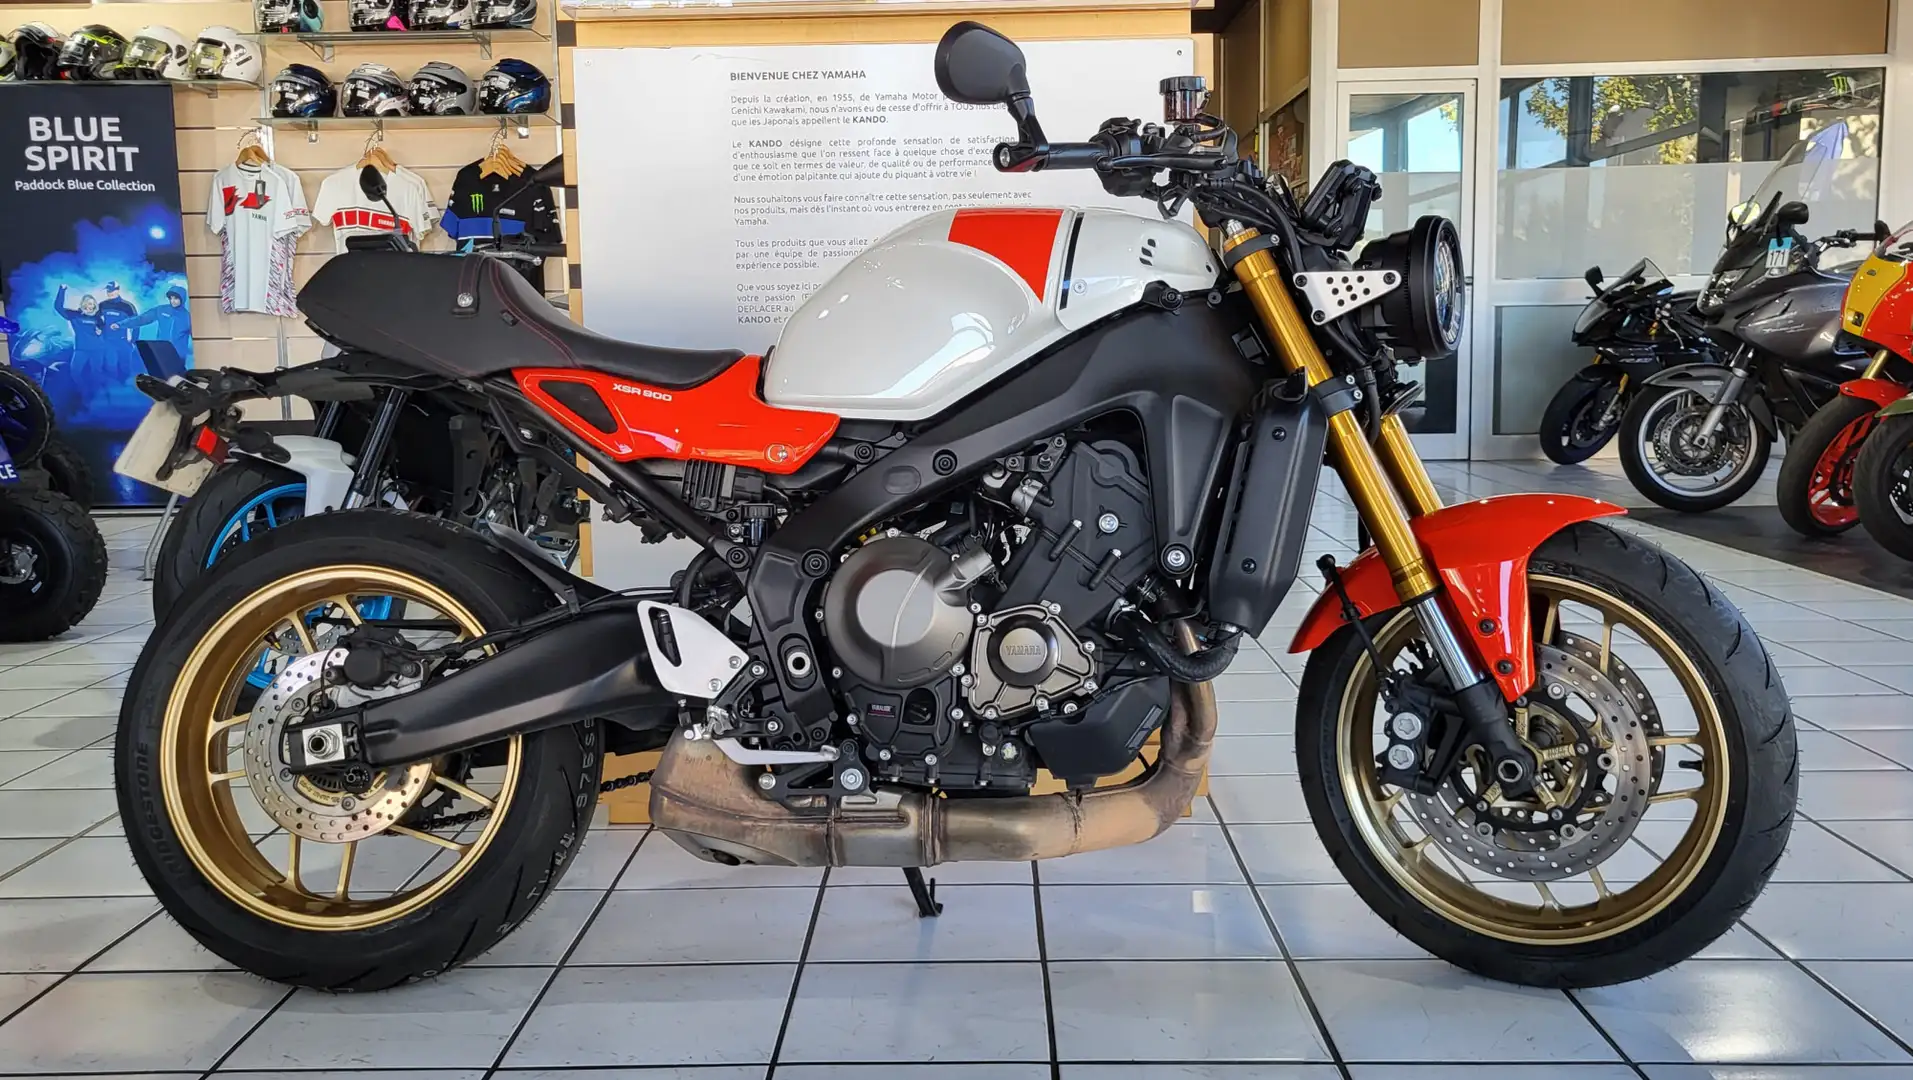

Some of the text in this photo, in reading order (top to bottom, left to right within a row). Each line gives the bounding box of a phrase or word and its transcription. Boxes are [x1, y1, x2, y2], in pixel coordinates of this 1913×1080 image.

[730, 70, 866, 81] BIENVENUE CHEZ YAMAHA
[730, 94, 760, 105] Depuis
[763, 94, 771, 102] la
[776, 93, 812, 103] création,
[832, 92, 855, 102] 1955,
[860, 92, 870, 101] de
[874, 91, 908, 100] Yamaha
[912, 91, 938, 100] Motor
[764, 105, 808, 115] Kawakami,
[830, 104, 862, 113] n'avons
[876, 103, 888, 112] de
[912, 102, 942, 111] d'offrir
[950, 103, 974, 111] TOUS
[992, 102, 1006, 110] clie
[731, 115, 888, 127] que les Japonais appellent le KANDO.
[28, 116, 122, 142] BLUE
[732, 139, 742, 148] Le
[748, 140, 782, 148] KANDO
[790, 138, 822, 149] désigne
[828, 137, 852, 146] cette
[857, 137, 897, 148] profonde
[902, 136, 944, 145] sensation
[950, 136, 960, 144] de
[24, 146, 140, 172] SPIRIT
[732, 149, 798, 159] d'enthousiasme
[801, 151, 817, 160] que
[820, 149, 836, 158] l'on
[840, 148, 870, 157] ressent
[872, 148, 892, 157] face
[902, 148, 937, 159] quelque
[940, 147, 964, 156] chose
[968, 147, 994, 156] d'exce
[732, 163, 748, 172] que
[762, 161, 778, 169] soit
[794, 160, 824, 169] termes
[826, 160, 836, 169] de
[838, 159, 866, 170] valeur,
[868, 159, 880, 168] de
[881, 159, 910, 170] qualité
[926, 159, 937, 167] de
[732, 172, 756, 181] d'une
[758, 171, 793, 180] émotion
[795, 171, 838, 182] palpitante
[839, 171, 852, 181] qui
[854, 170, 880, 181] ajoute
[882, 170, 894, 179] du
[895, 170, 927, 180] piquant
[936, 169, 958, 178] votre
[960, 169, 972, 178] vie
[15, 179, 156, 192] Paddock Blue Collection
[734, 194, 755, 203] Nous
[756, 194, 800, 203] souhaitons
[824, 193, 844, 202] faire
[844, 192, 884, 201] connaître
[885, 192, 908, 201] cette
[908, 191, 951, 202] sensation,
[952, 193, 966, 202] pas
[968, 190, 1012, 199] seulement
[750, 204, 788, 216] produits,
[789, 204, 809, 213] mais
[810, 204, 825, 213] dès
[826, 203, 860, 212] l'instant
[861, 203, 872, 212] où
[894, 202, 930, 211] entrerez
[734, 216, 769, 225] Yamaha.
[736, 238, 755, 247] Tous
[757, 238, 769, 247] les
[771, 238, 806, 249] produits
[808, 240, 824, 248] que
[848, 238, 868, 246] allez
[736, 251, 750, 260] par
[774, 249, 803, 260] équipe
[808, 249, 818, 257] de
[822, 248, 862, 259] passionn
[736, 260, 820, 271] expérience possible.
[736, 282, 754, 293] Que
[776, 283, 800, 292] soyez
[802, 281, 810, 290] ici
[736, 293, 760, 302] votre
[764, 292, 796, 303] passion
[737, 305, 782, 313] DEPLACER
[738, 316, 771, 324] KANDO
[613, 383, 672, 402] XSR 900
[1006, 645, 1041, 656] YAMAHA
